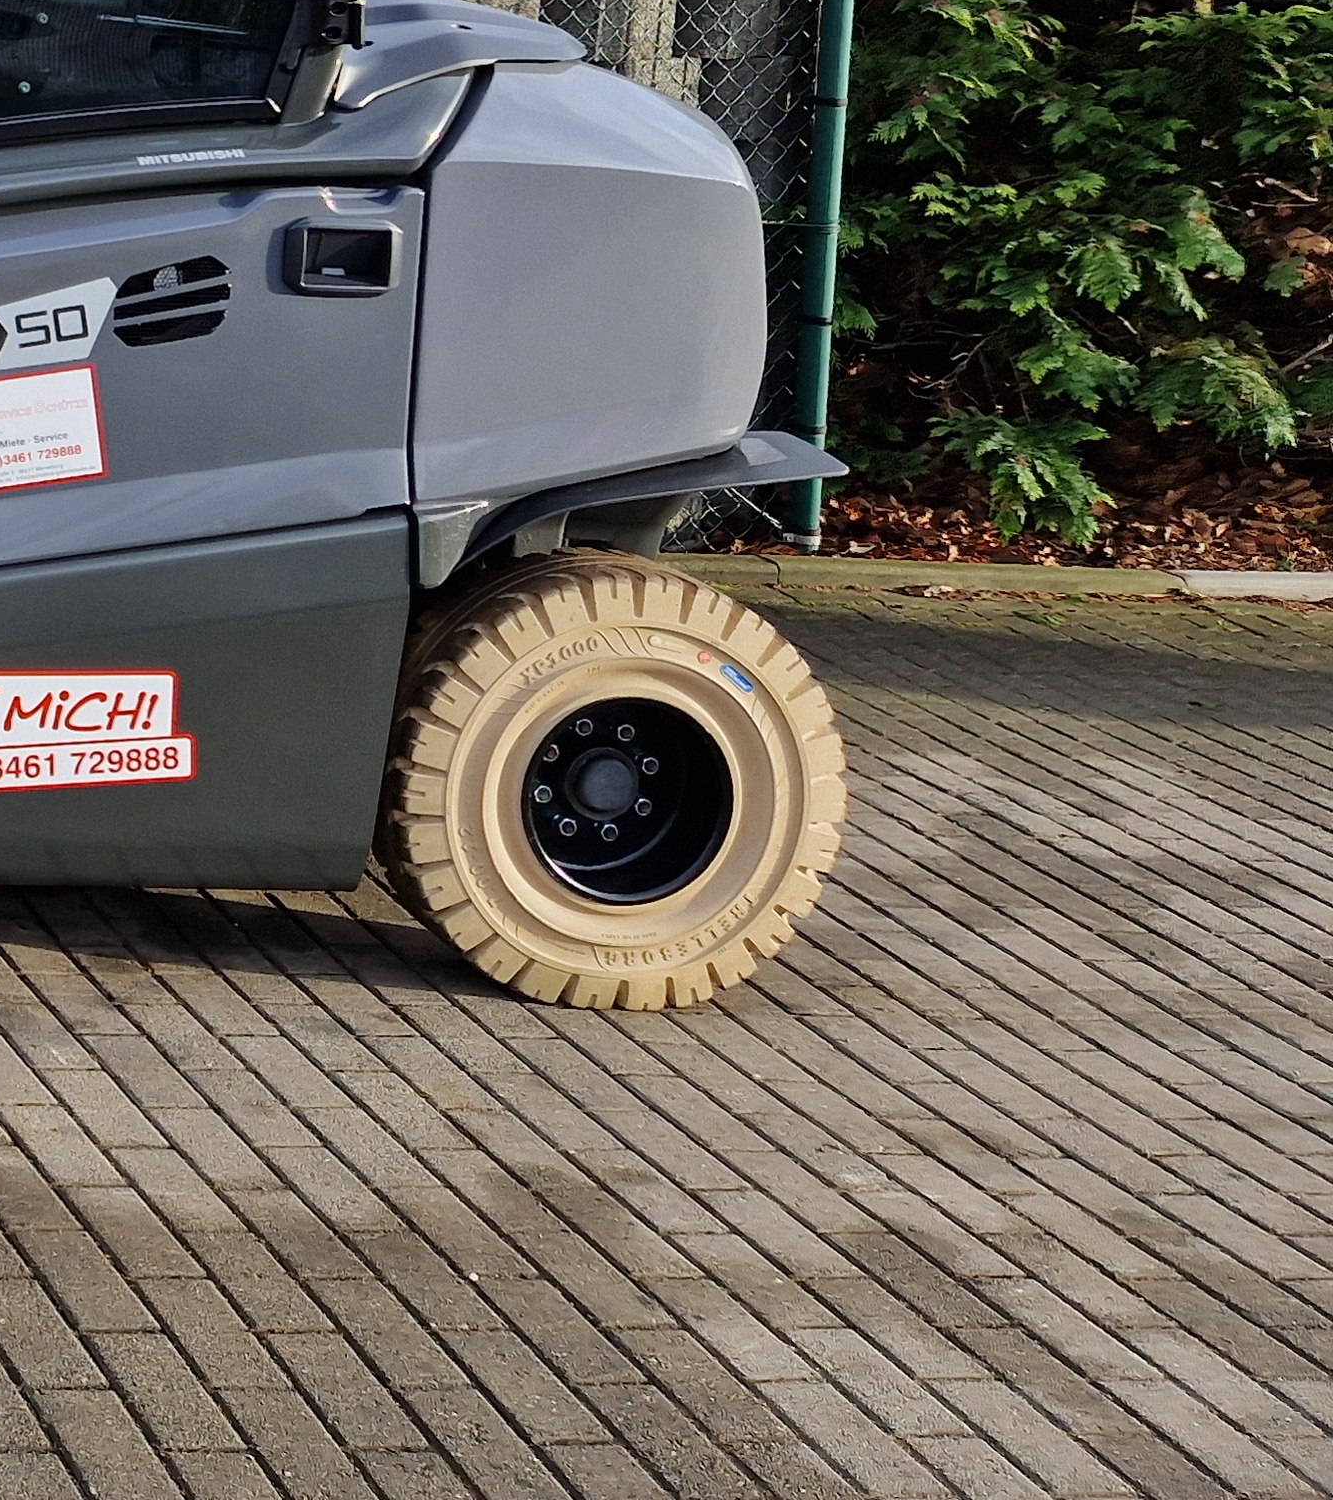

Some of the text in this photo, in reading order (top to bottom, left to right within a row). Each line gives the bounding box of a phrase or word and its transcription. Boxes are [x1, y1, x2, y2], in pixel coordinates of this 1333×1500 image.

[135, 148, 247, 166] MITSUBISHI
[15, 305, 89, 349] 50
[0, 439, 26, 449] Miete
[33, 432, 68, 444] Service
[37, 444, 82, 460] 729888
[70, 746, 179, 776] 729888
[603, 893, 758, 967] TRELLEBORG
